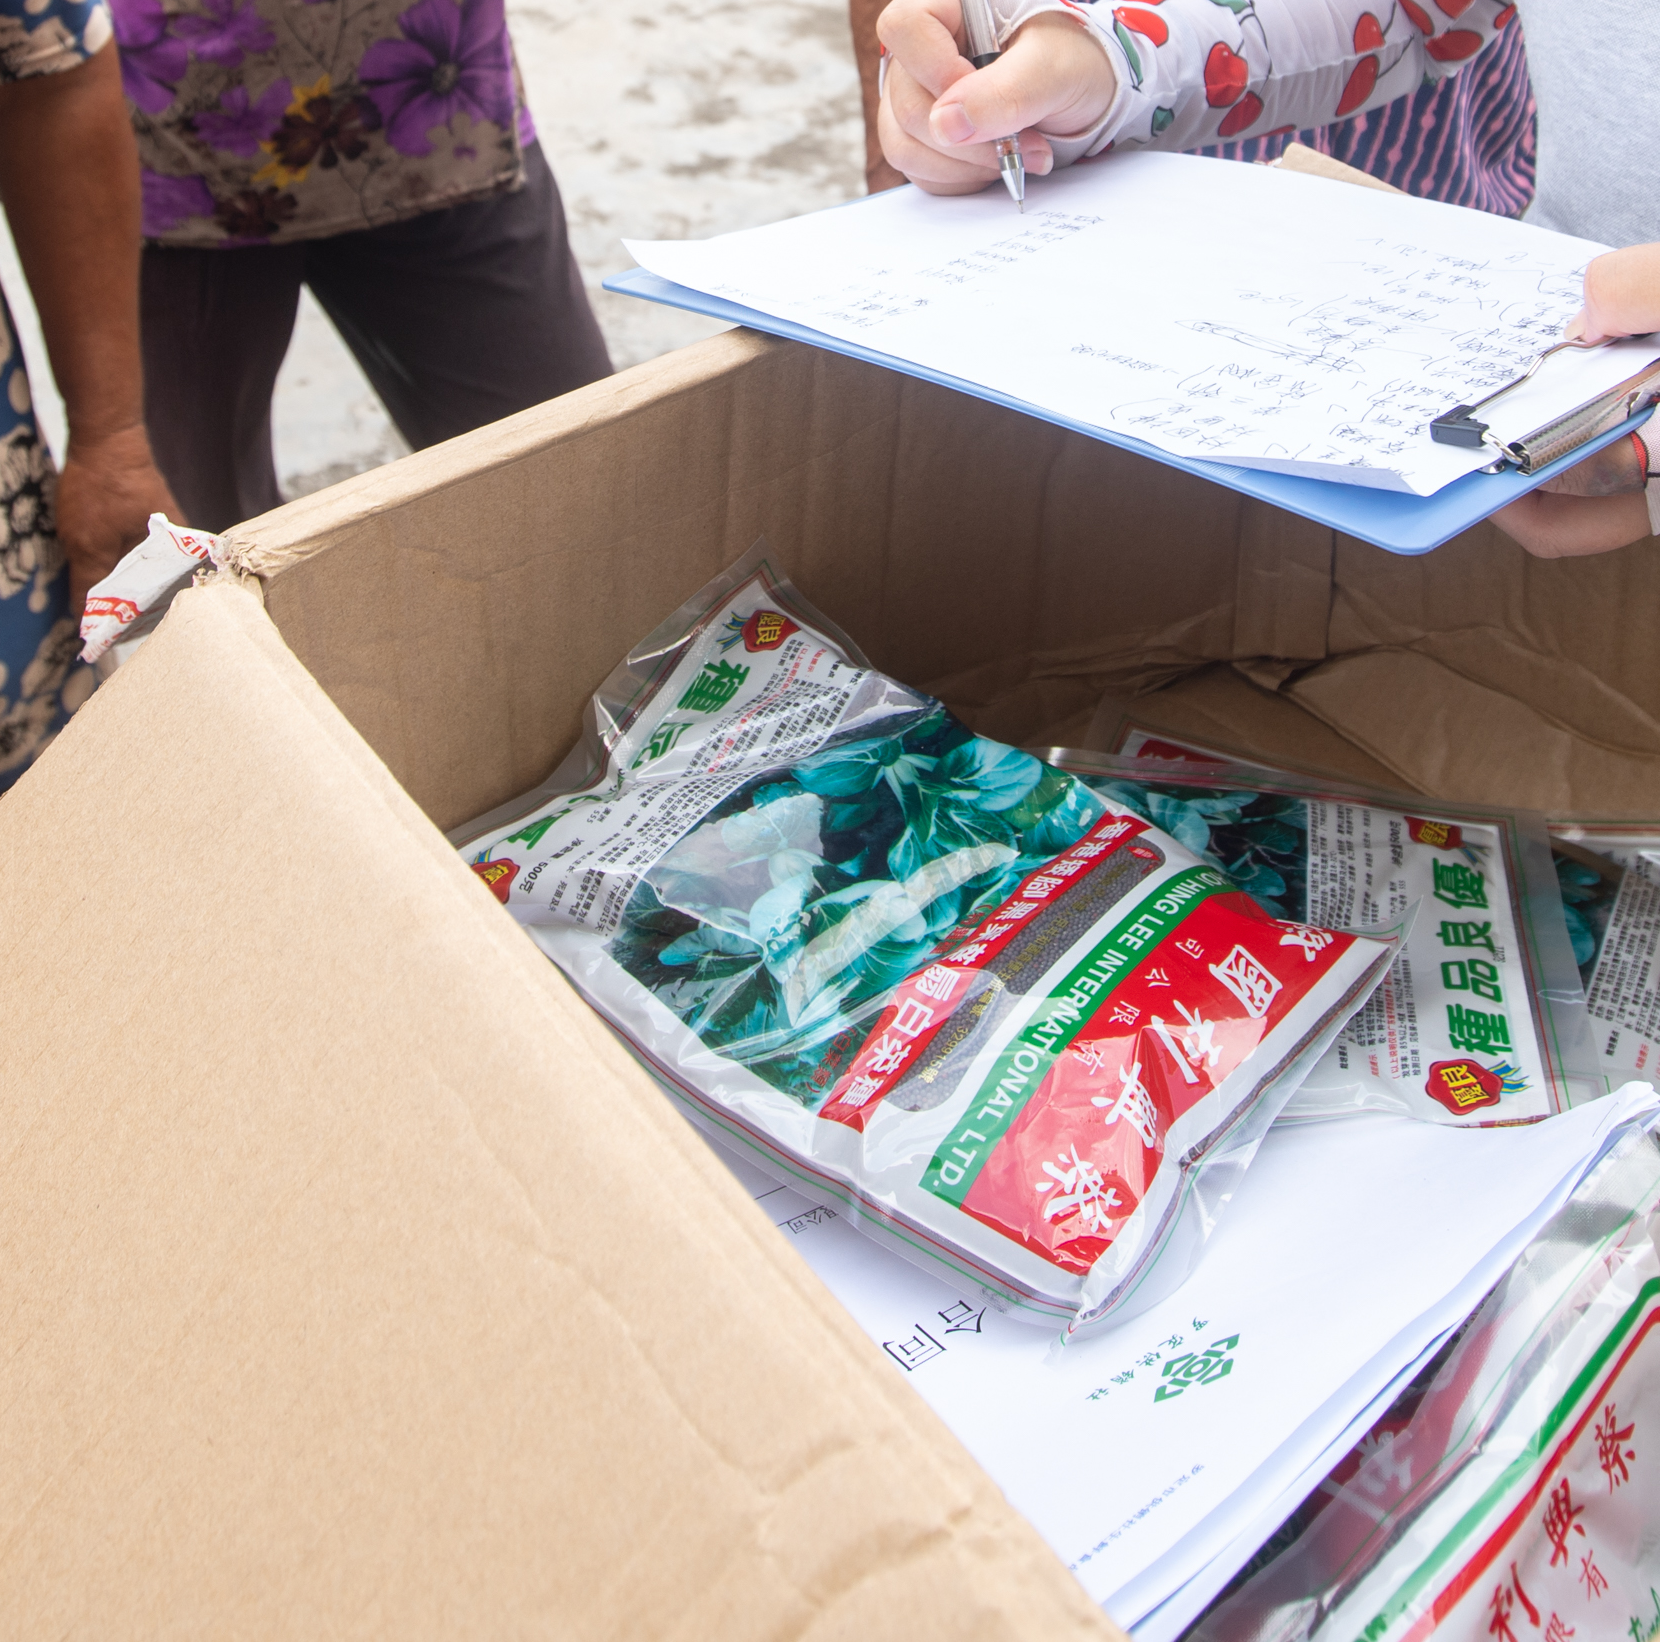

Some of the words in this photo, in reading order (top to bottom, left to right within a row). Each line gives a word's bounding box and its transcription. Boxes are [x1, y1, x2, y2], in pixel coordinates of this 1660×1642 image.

[1155, 878, 1199, 916] HING
[1117, 913, 1161, 950] LEE
[977, 948, 1124, 1127] INTERNATIONAL
[1439, 1063, 1488, 1107] 優良
[932, 1128, 986, 1187] LTD.
[882, 1300, 986, 1371] 合同
